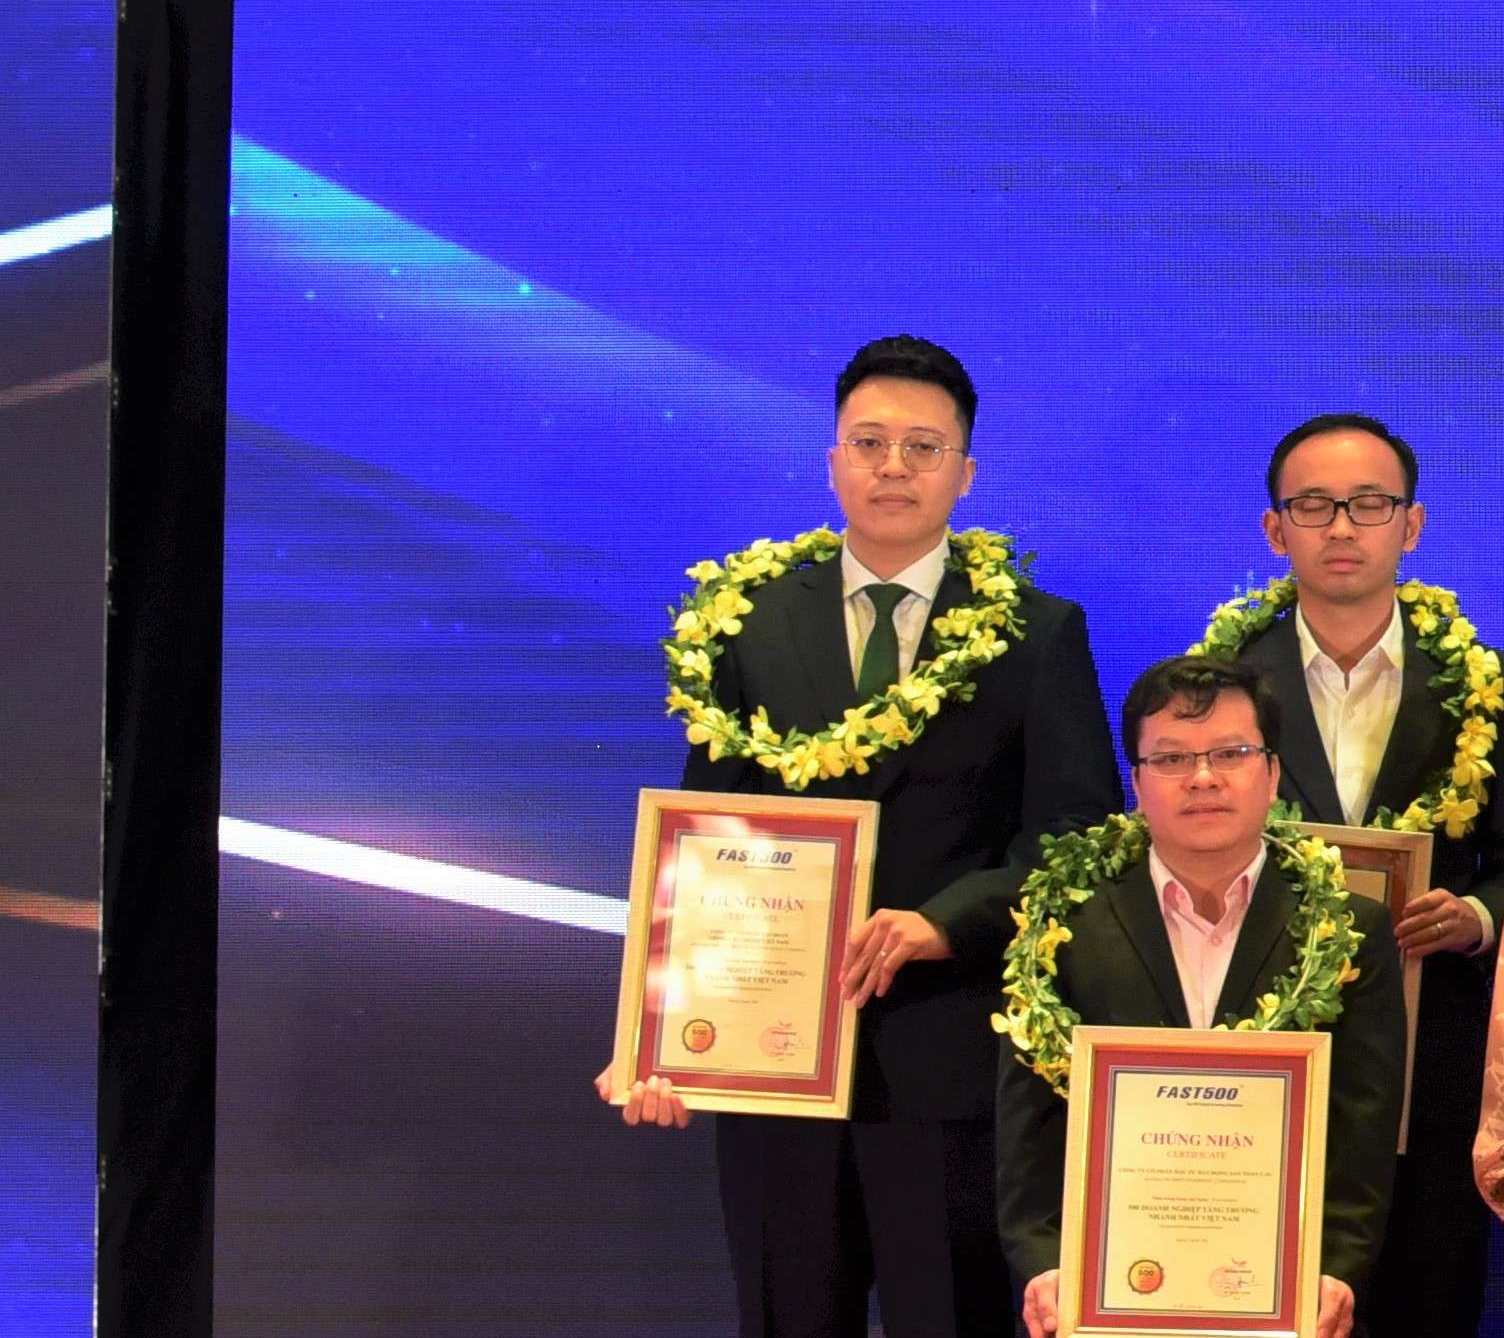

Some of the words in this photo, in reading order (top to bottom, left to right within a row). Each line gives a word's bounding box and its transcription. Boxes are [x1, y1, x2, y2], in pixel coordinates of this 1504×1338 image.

[1156, 1085, 1239, 1100] FAST500
[1141, 1130, 1201, 1146] CHỨNG
[1206, 1133, 1254, 1149] NHẬN
